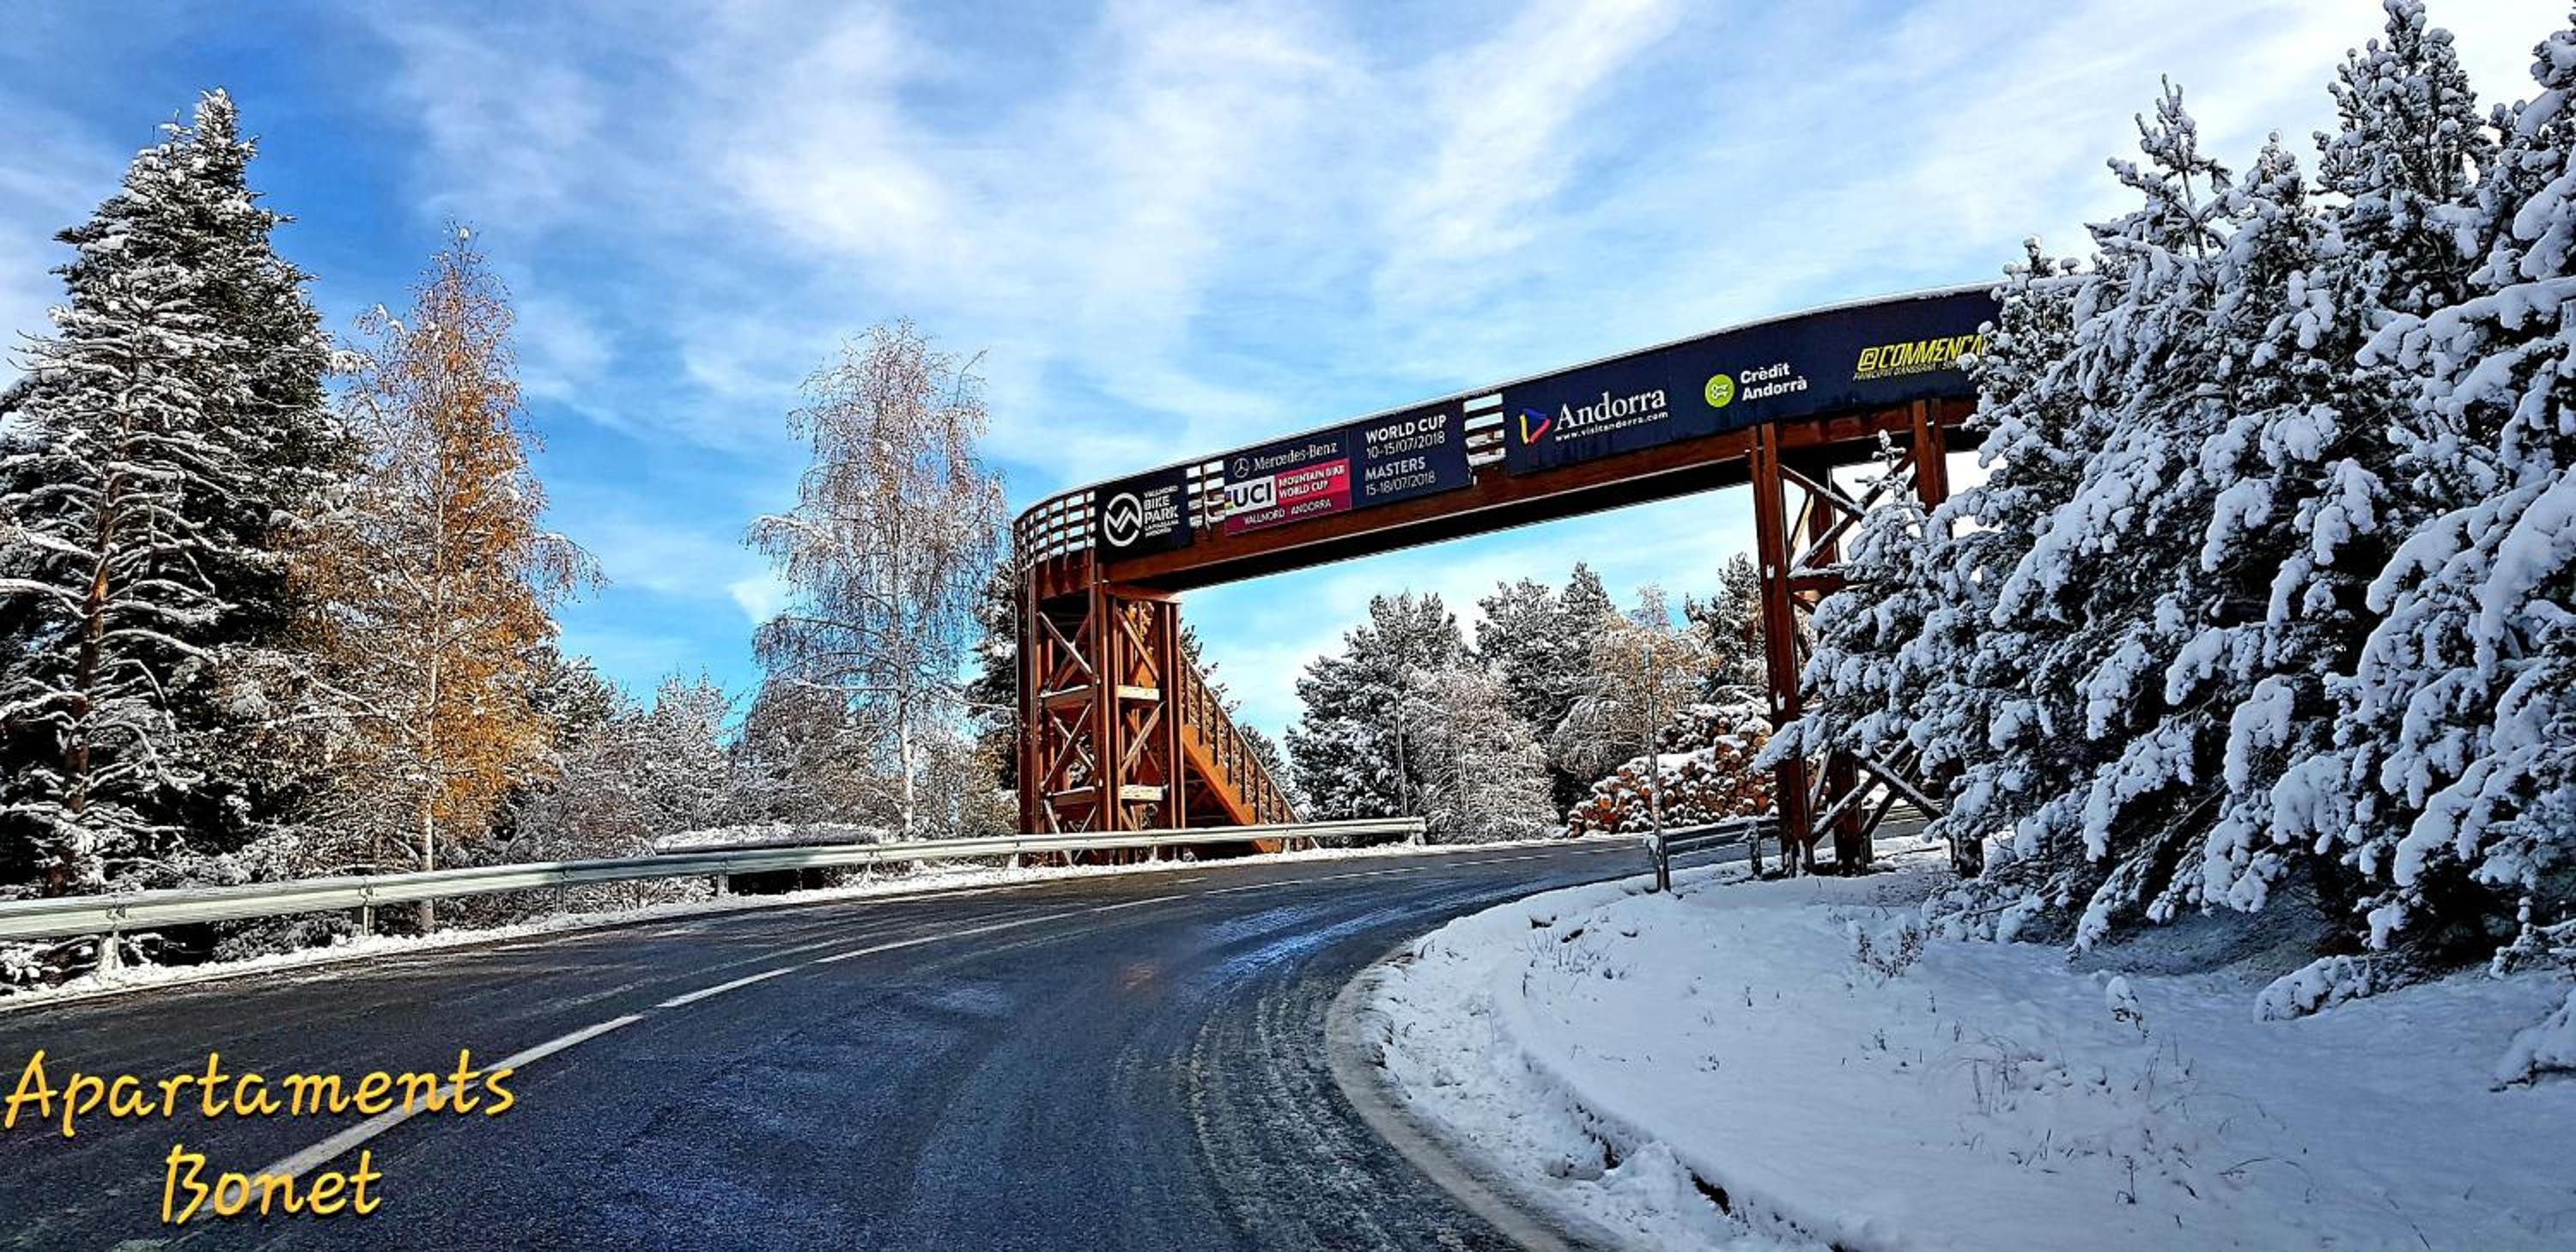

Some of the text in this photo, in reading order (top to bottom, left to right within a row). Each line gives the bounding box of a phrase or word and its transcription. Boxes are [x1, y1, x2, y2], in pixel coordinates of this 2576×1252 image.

[1740, 362, 1790, 385] Crèdit
[1741, 375, 1807, 401] Andorrà
[1552, 388, 1667, 432] Andorra
[1365, 414, 1447, 444] WORLD CUP
[1555, 411, 1669, 441] www.visitandorra.com
[1255, 442, 1338, 471] Mercedes-Benz
[1366, 430, 1445, 459] 10-15/07/2018
[1278, 470, 1325, 488] MOUNTAIN
[1364, 456, 1426, 481] MASTERS
[1233, 482, 1272, 507] UCI
[1278, 480, 1328, 498] WORLD CUP
[1365, 470, 1436, 495] 15-18/07/2018
[1143, 495, 1170, 511] BIKE
[1144, 505, 1179, 525] PARK
